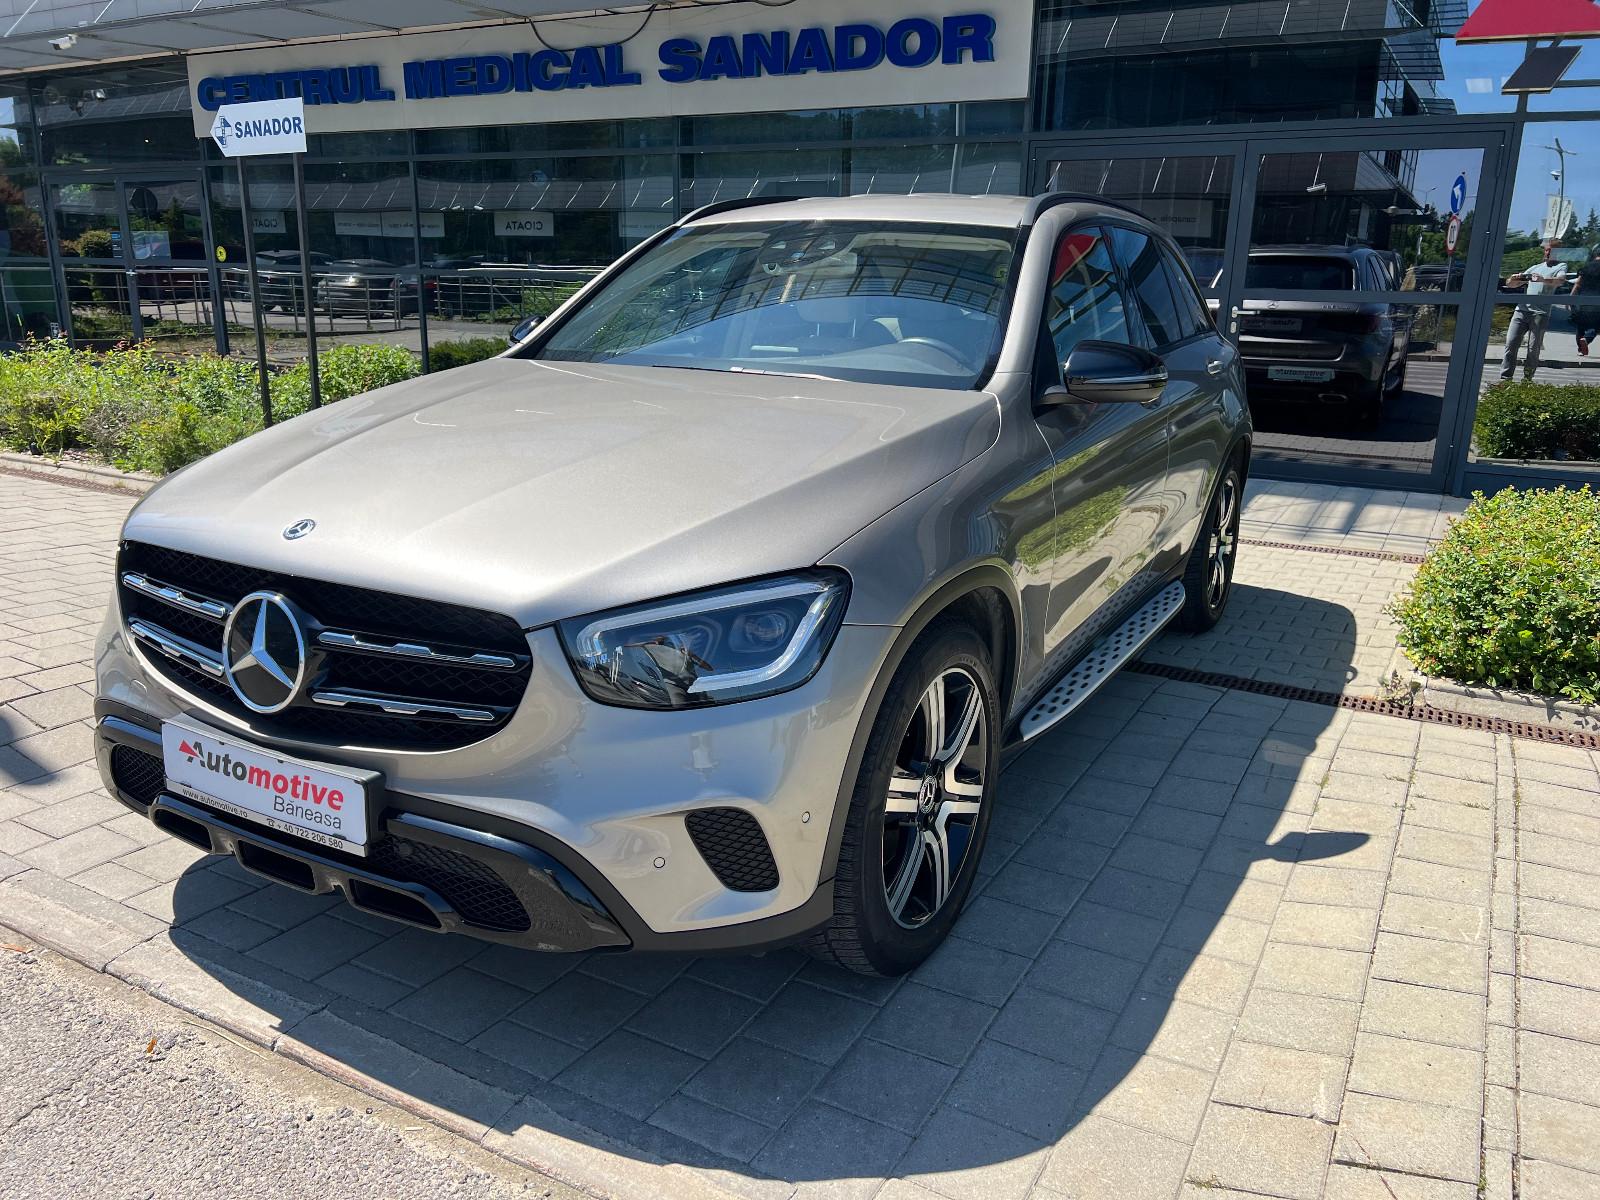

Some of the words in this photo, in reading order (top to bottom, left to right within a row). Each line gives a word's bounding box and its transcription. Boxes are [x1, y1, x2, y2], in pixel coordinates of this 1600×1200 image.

[197, 65, 396, 112] CENTRUL
[403, 43, 641, 99] MEDICAL
[658, 13, 997, 83] SANADOR
[234, 116, 303, 139] SANADOR
[178, 739, 344, 811] Automotive
[182, 788, 249, 818] www.automotive.ro
[273, 795, 342, 830] Băneasa
[294, 826, 310, 839] 722
[311, 830, 327, 843] 206
[328, 836, 344, 850] 580
